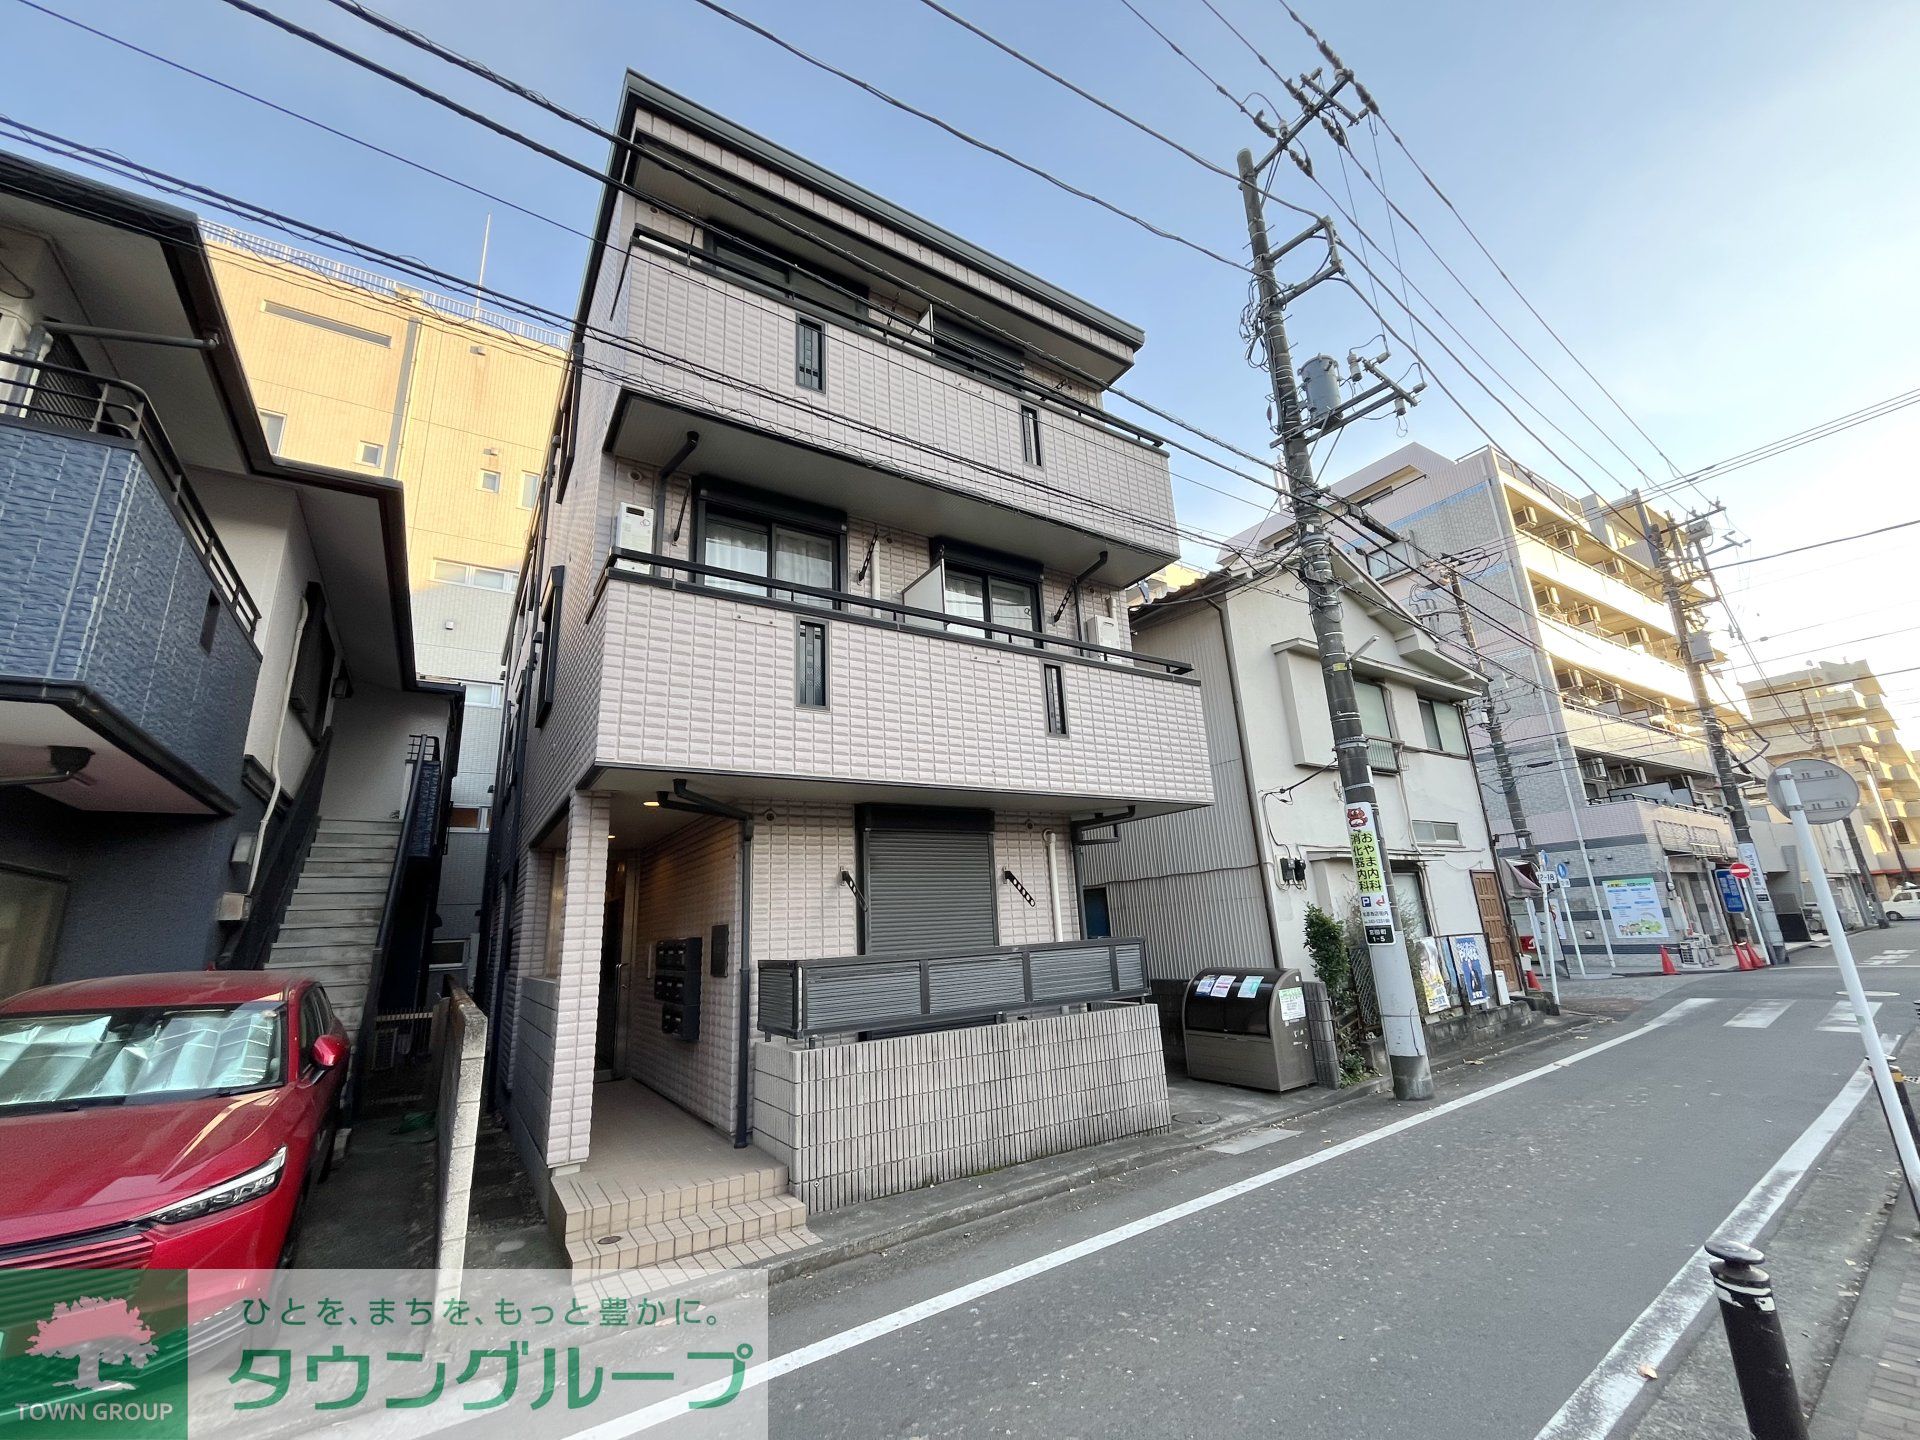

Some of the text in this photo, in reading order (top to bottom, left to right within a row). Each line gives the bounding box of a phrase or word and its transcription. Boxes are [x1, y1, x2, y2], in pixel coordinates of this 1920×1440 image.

[1350, 833, 1370, 892] 消化器内科
[1361, 832, 1381, 891] おやま内科
[1537, 873, 1555, 881] 12-18
